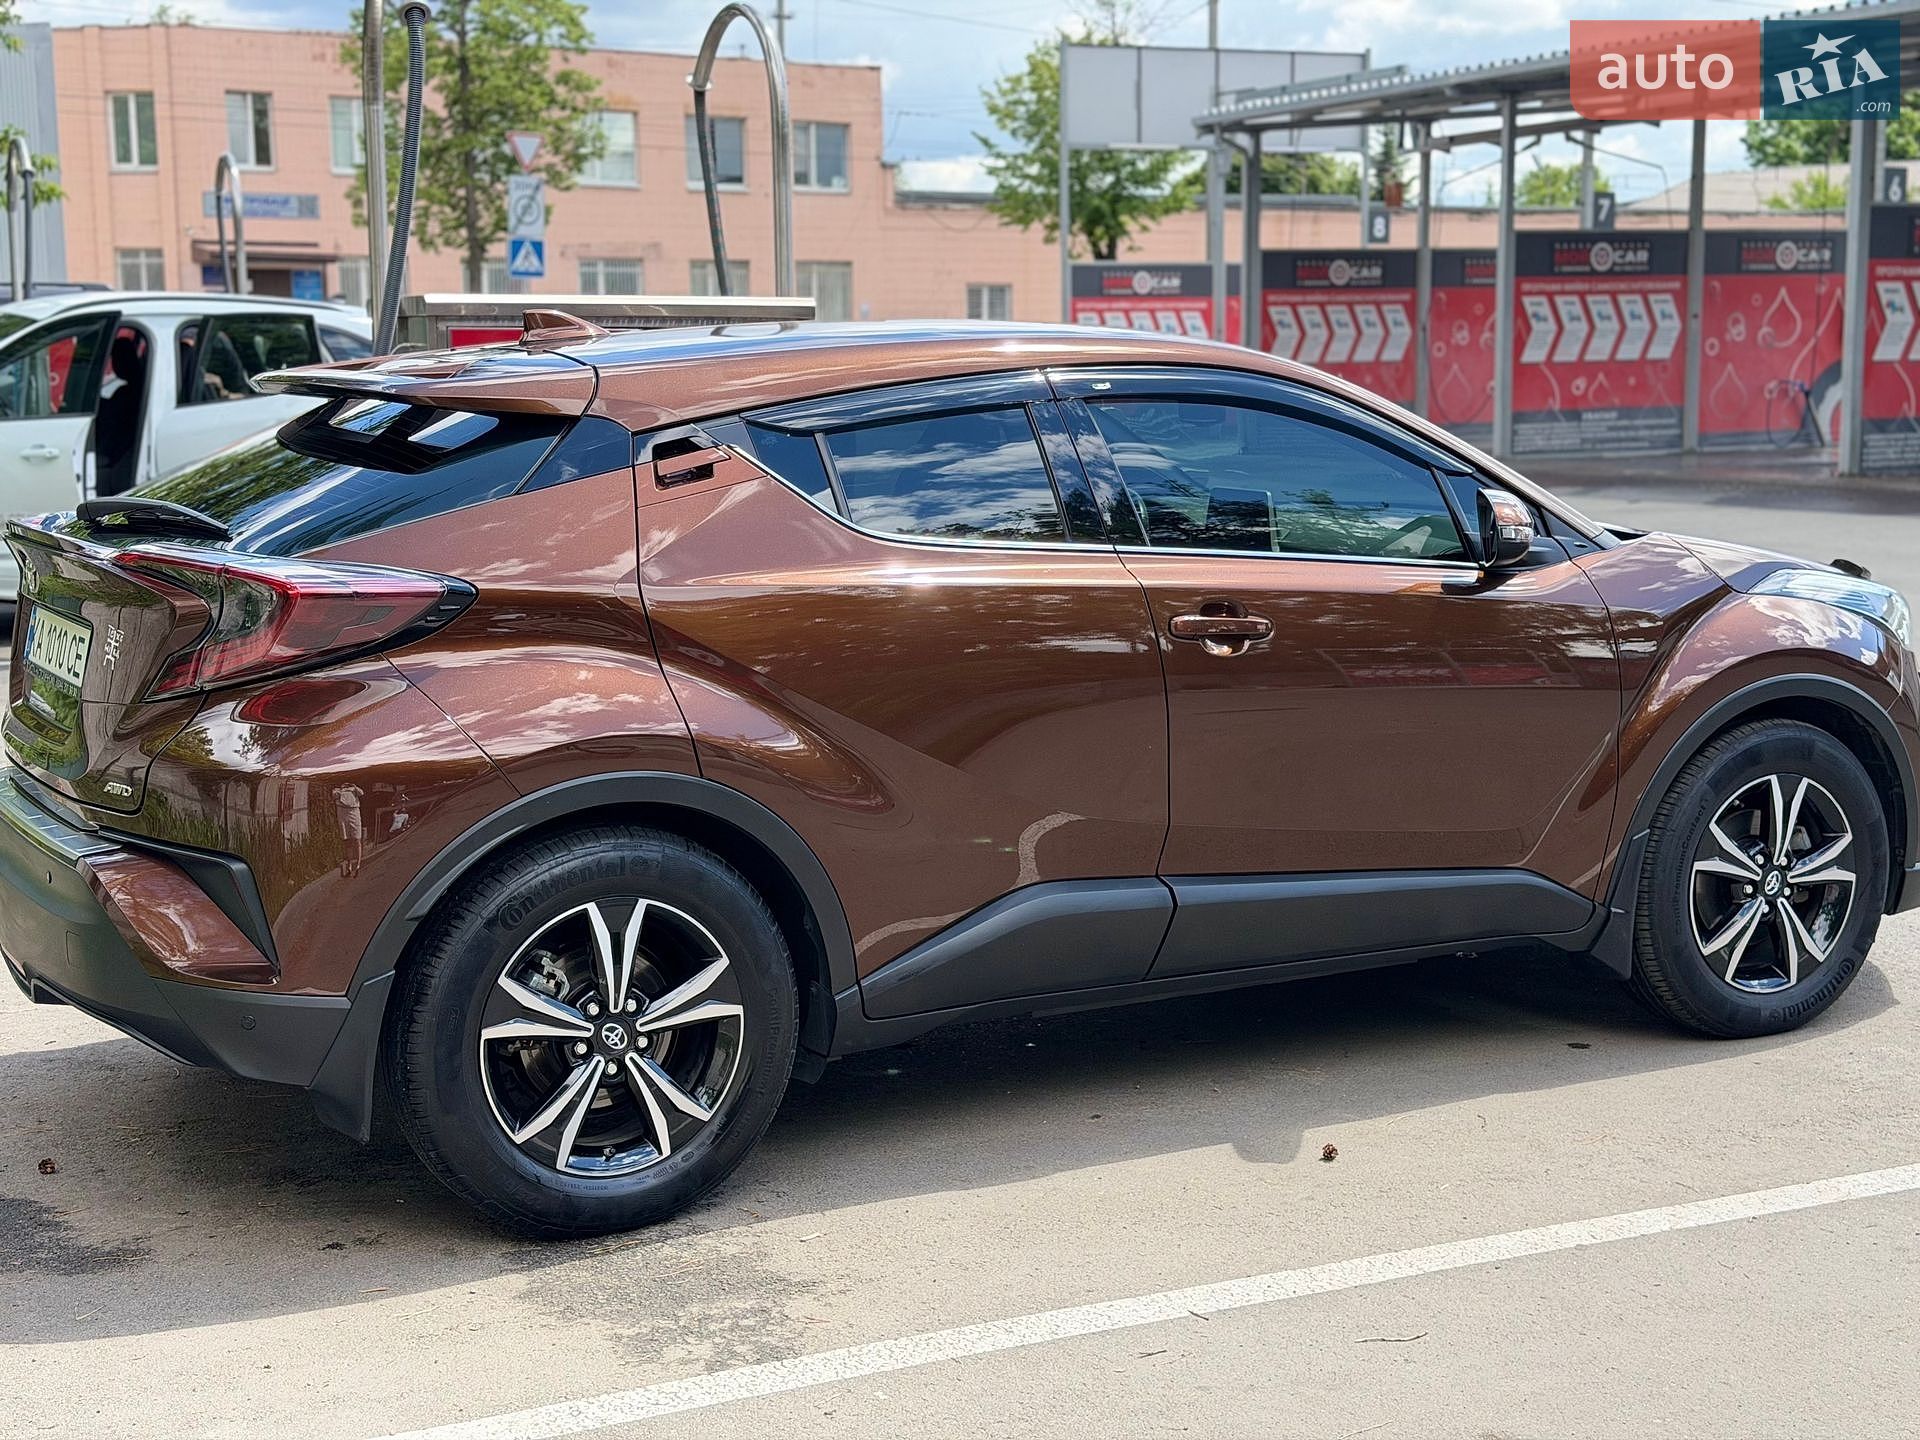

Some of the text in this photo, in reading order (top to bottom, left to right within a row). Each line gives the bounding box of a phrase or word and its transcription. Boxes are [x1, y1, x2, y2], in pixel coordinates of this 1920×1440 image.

[1888, 175, 1903, 203] 6
[1597, 198, 1612, 223] 7
[1372, 215, 1387, 240] 8
[1613, 249, 1649, 264] CAR
[45, 623, 69, 671] 1010
[66, 633, 86, 679] CE
